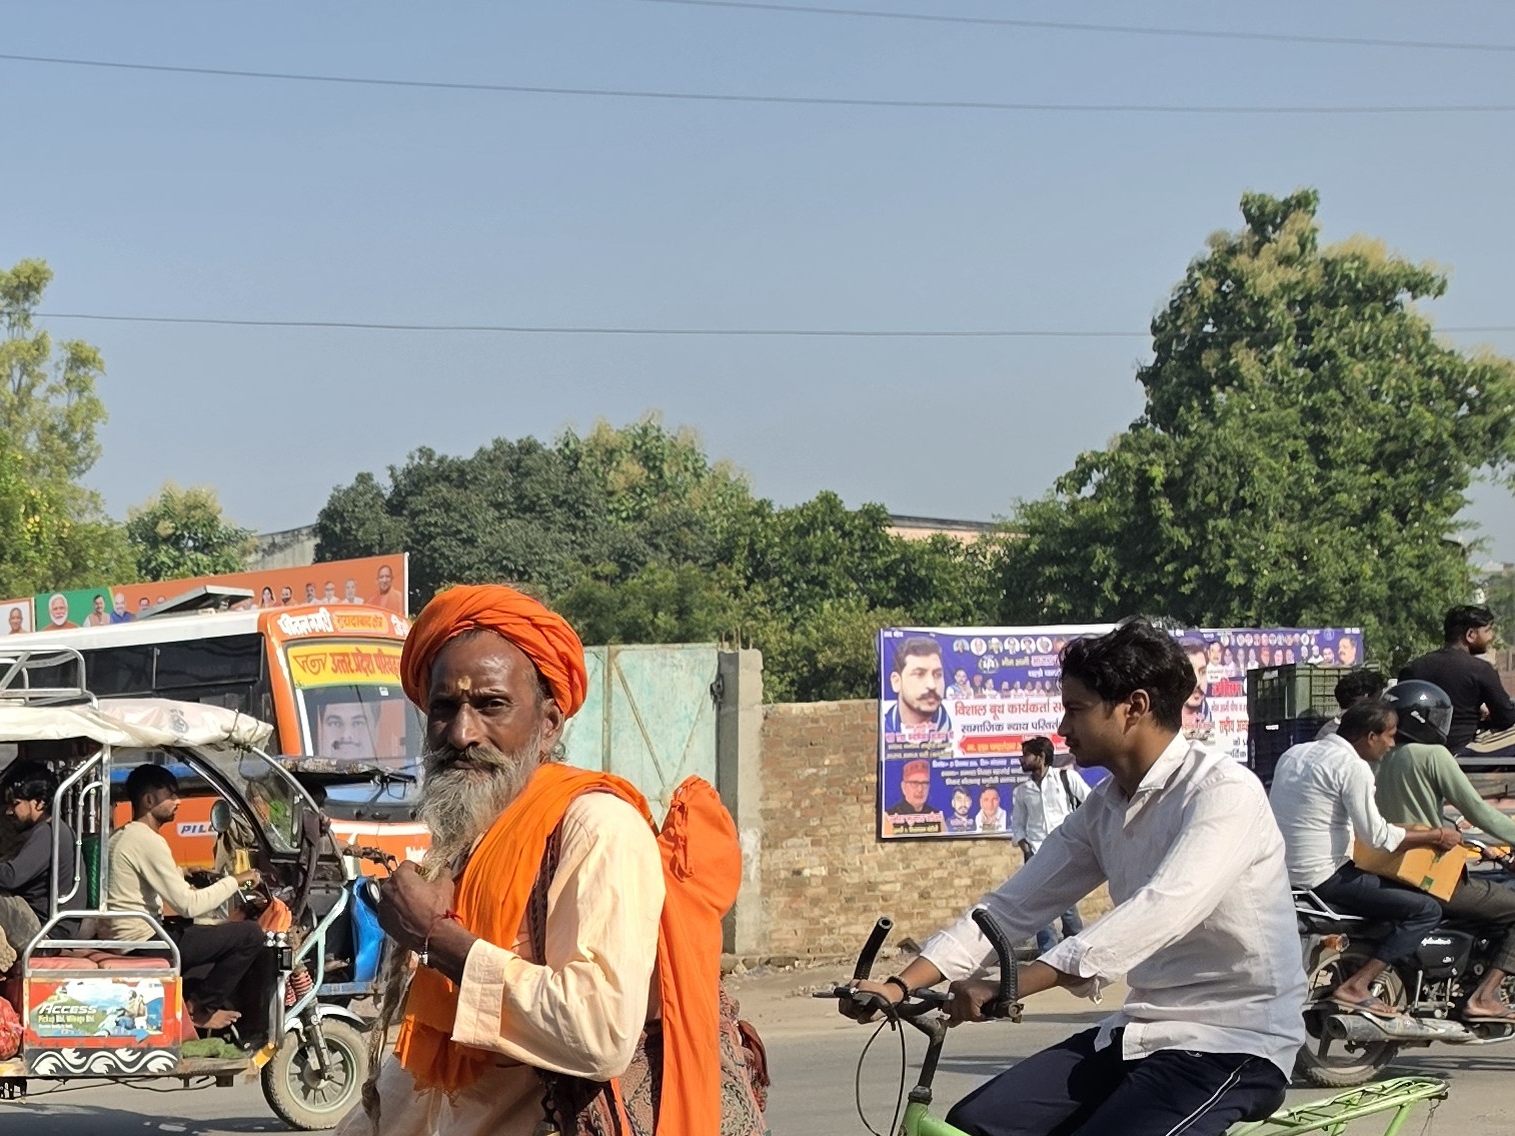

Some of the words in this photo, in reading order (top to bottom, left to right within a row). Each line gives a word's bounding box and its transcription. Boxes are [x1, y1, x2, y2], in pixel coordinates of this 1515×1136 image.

[373, 648, 401, 680] परिवह
[954, 701, 986, 717] विशाल
[1007, 699, 1050, 716] कार्यकर्ता
[961, 720, 1004, 734] सामाजिक
[1031, 718, 1061, 731] परिवर्त
